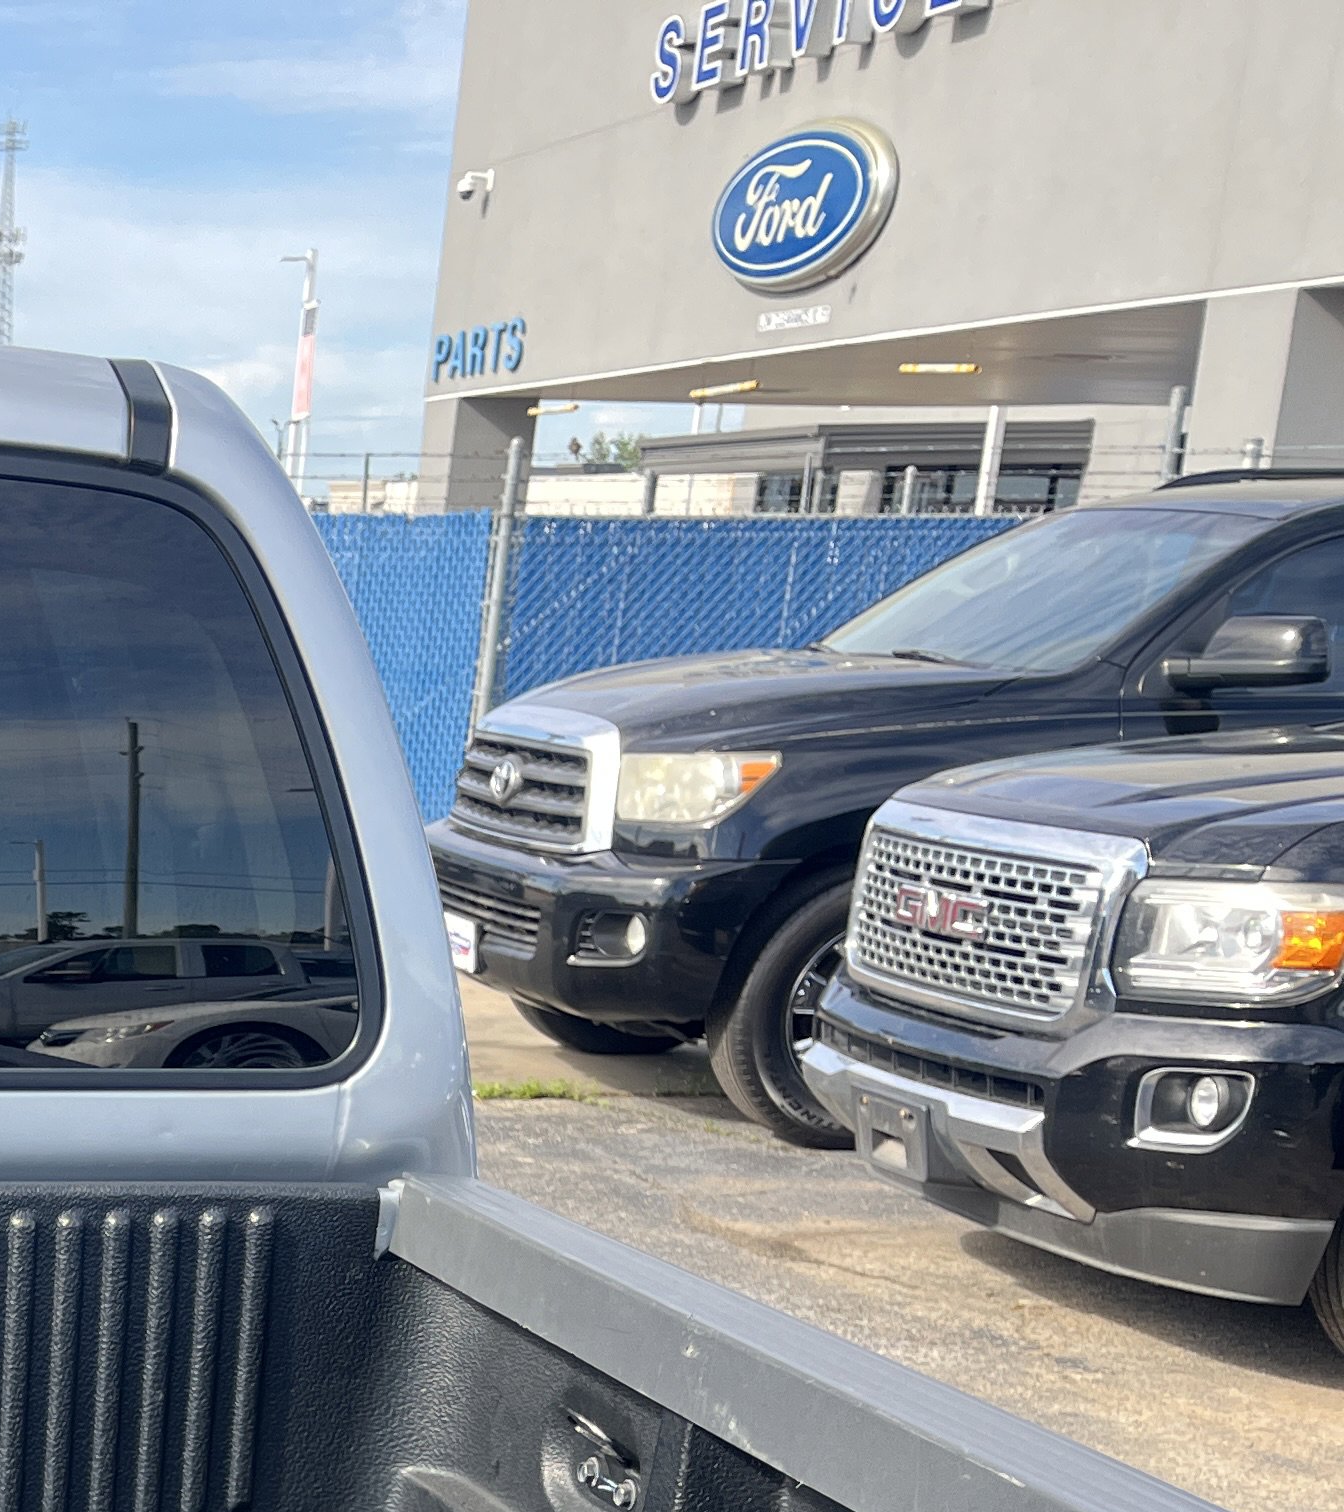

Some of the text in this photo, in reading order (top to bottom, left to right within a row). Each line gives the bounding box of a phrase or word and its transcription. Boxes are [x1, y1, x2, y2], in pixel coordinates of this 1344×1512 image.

[650, 0, 963, 104] SERVI
[733, 158, 834, 252] Ford
[431, 316, 527, 384] PARTS
[895, 883, 989, 941] GMC
